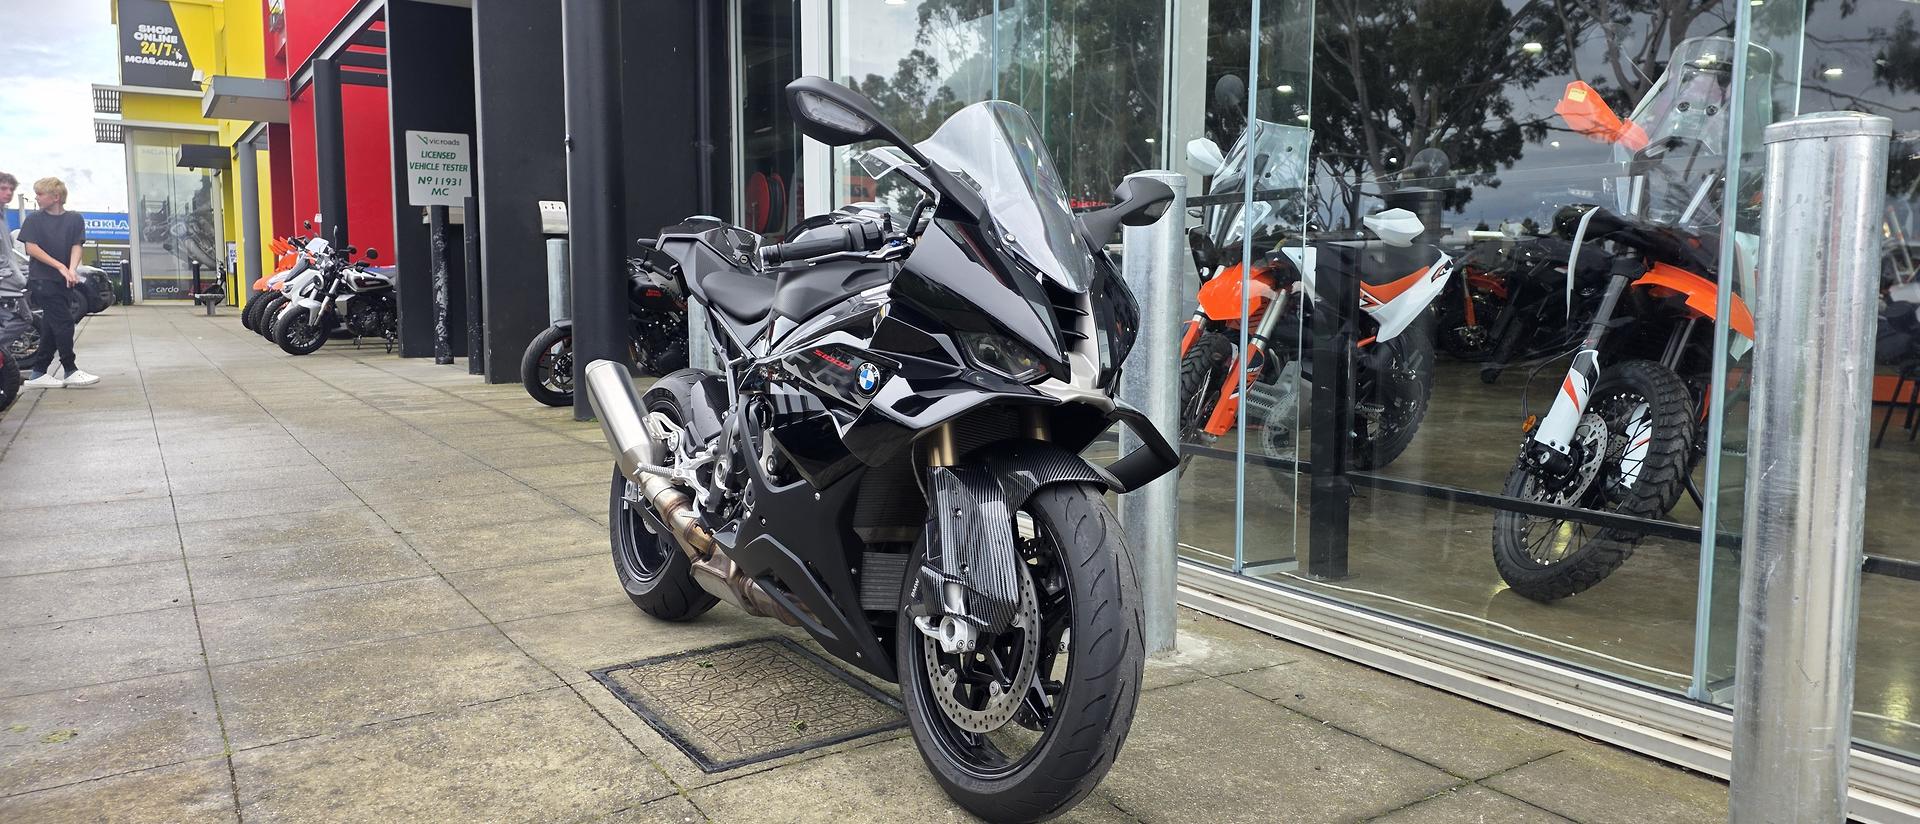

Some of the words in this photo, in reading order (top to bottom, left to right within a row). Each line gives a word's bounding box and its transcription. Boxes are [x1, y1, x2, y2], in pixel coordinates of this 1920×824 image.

[138, 24, 173, 35] SHOP
[133, 31, 178, 44] ONLINE
[141, 41, 172, 56] 24/7
[421, 150, 456, 160] LICENSED
[409, 161, 440, 171] VEHICLE
[442, 163, 468, 172] TESTER
[431, 187, 450, 196] MC
[910, 577, 920, 598] BMW
